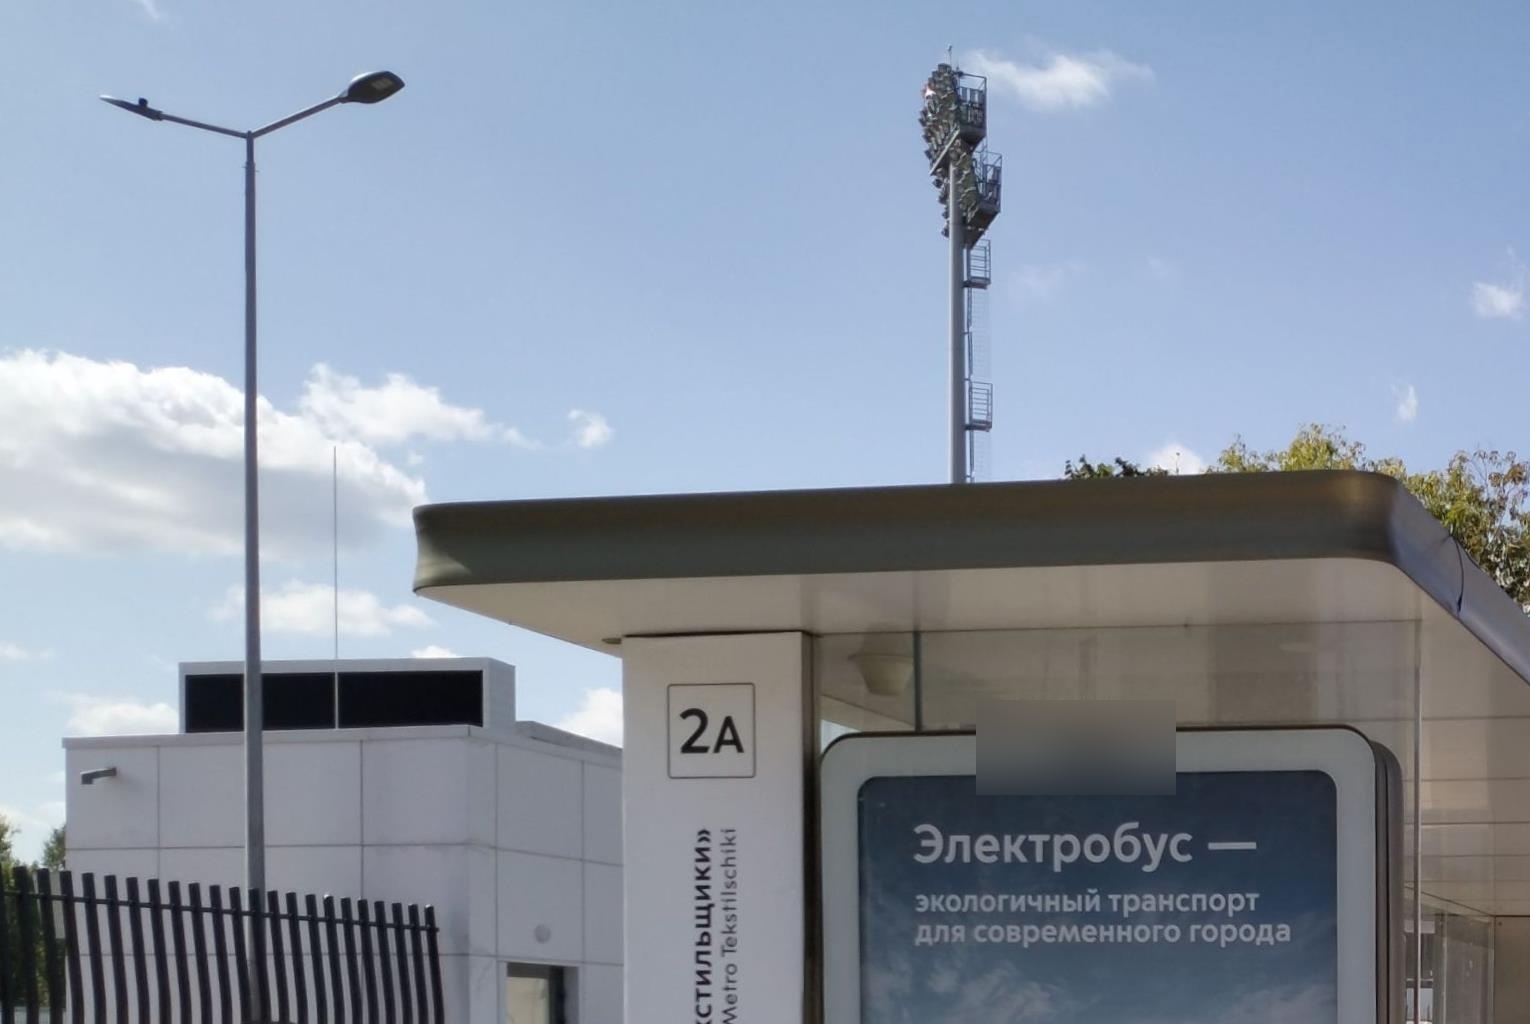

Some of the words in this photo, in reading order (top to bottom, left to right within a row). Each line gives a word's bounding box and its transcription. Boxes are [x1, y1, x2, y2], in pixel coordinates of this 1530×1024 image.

[913, 821, 1193, 873] Электробус
[720, 828, 738, 957] Tekstilschiki
[914, 888, 1101, 913] экологичный
[1108, 892, 1260, 918] транспорт
[914, 924, 966, 946] для
[974, 922, 1181, 948] современного
[1189, 922, 1292, 947] города
